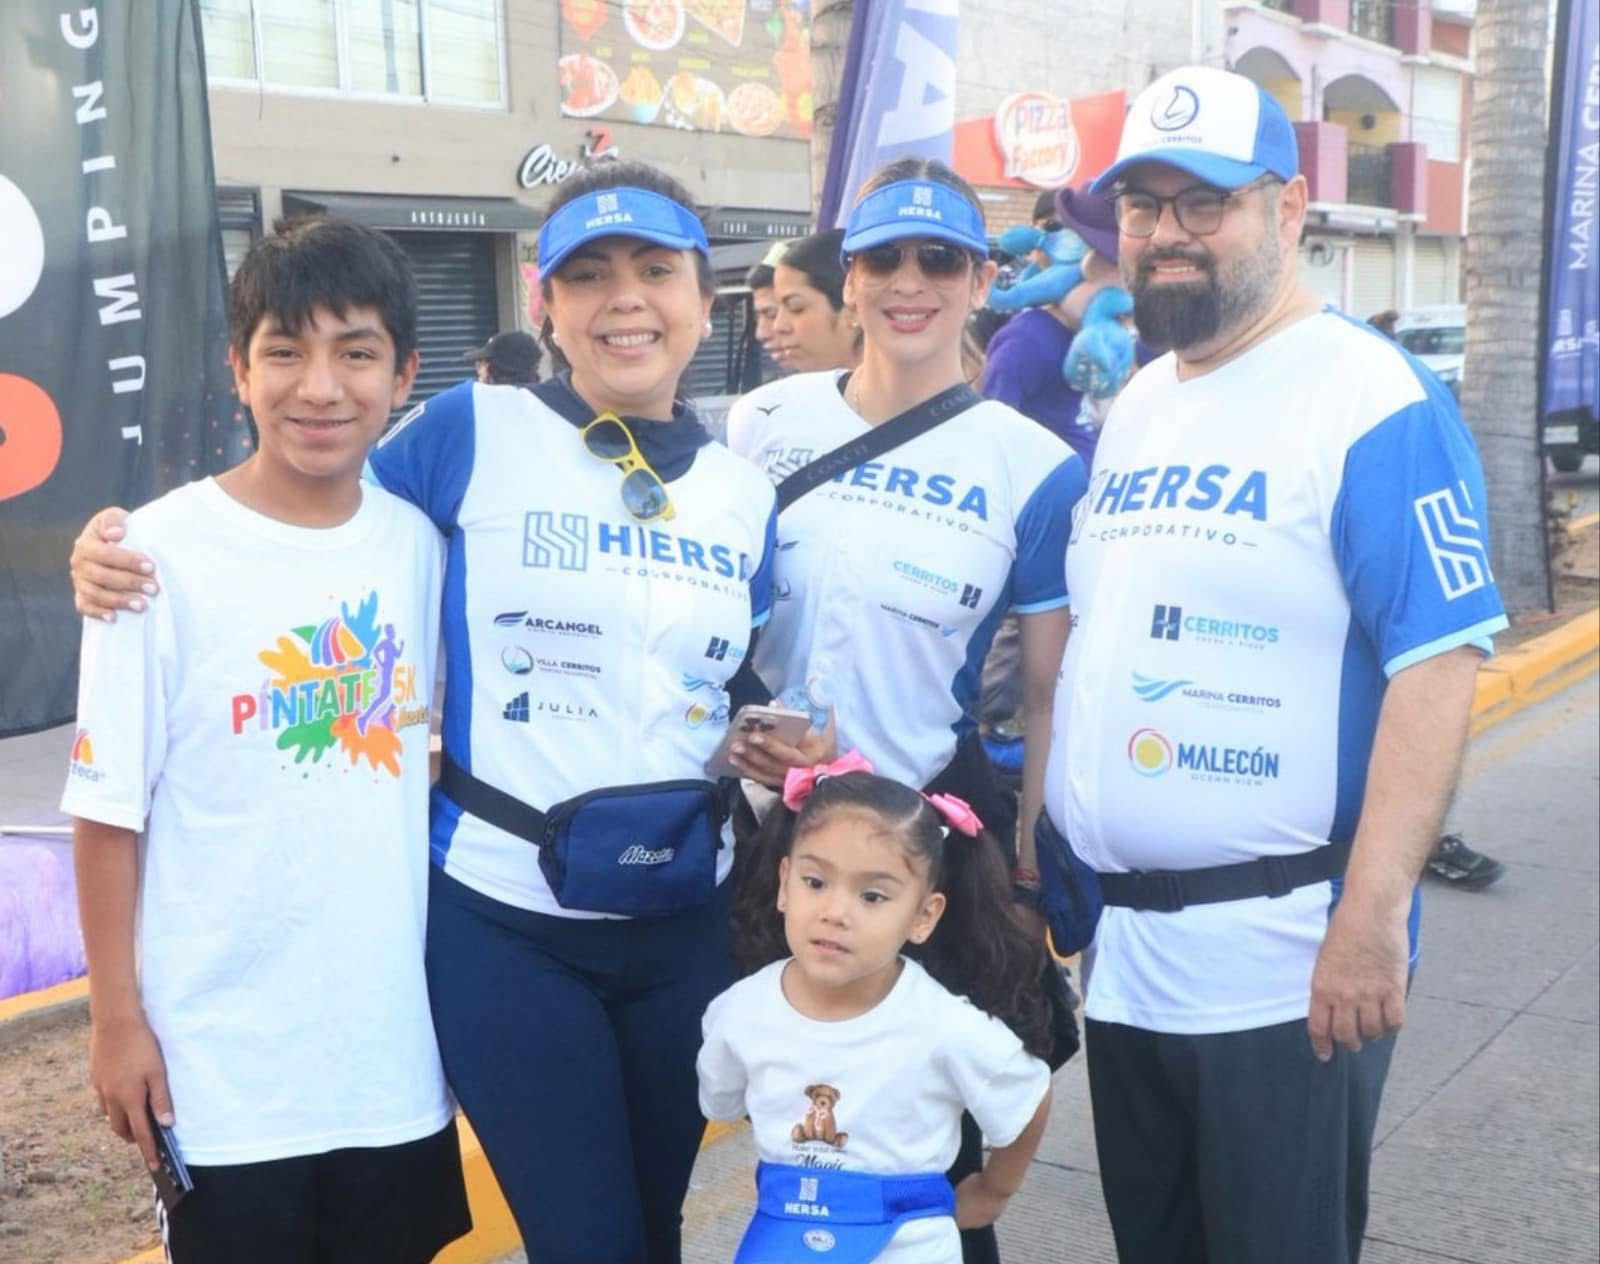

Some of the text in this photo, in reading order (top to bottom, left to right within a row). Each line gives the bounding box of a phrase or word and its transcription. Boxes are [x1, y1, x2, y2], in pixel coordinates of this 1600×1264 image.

[898, 206, 943, 221] HERSA
[1568, 142, 1599, 271] MARINA
[60, 7, 146, 446] JUMPING
[586, 214, 633, 230] HERSA
[831, 462, 989, 522] ERSA
[1094, 465, 1267, 522] HERSA
[525, 618, 603, 636] ARCANGEL
[1184, 615, 1279, 643] CERRITOS
[538, 701, 598, 718] JULIA
[1182, 688, 1225, 701] MARINA
[1227, 692, 1281, 709] CERRITOS
[1177, 742, 1280, 779] MALECÓN
[784, 1202, 830, 1217] HERSA
